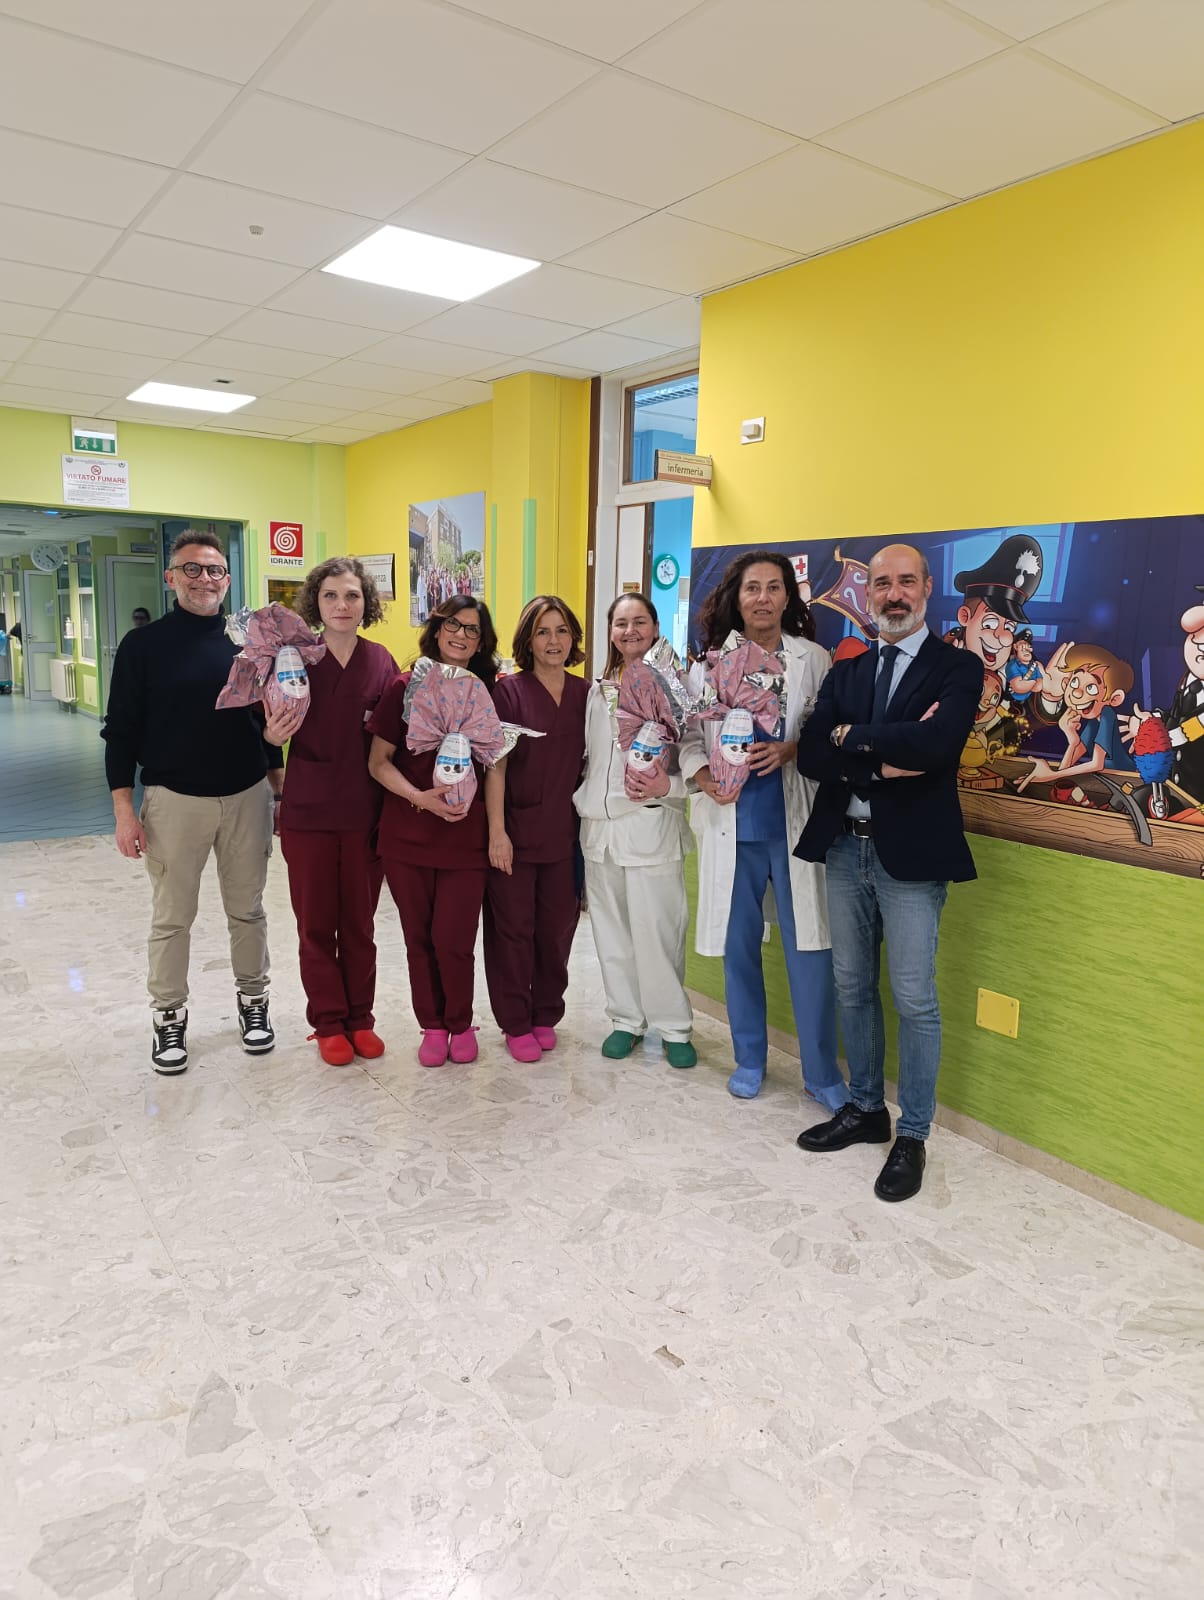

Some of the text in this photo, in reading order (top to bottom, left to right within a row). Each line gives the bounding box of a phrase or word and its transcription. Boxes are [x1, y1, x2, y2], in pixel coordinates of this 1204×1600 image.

[667, 463, 704, 477] infermeria
[66, 472, 127, 484] VIETATO FUMARE
[270, 557, 304, 566] IDRANTE
